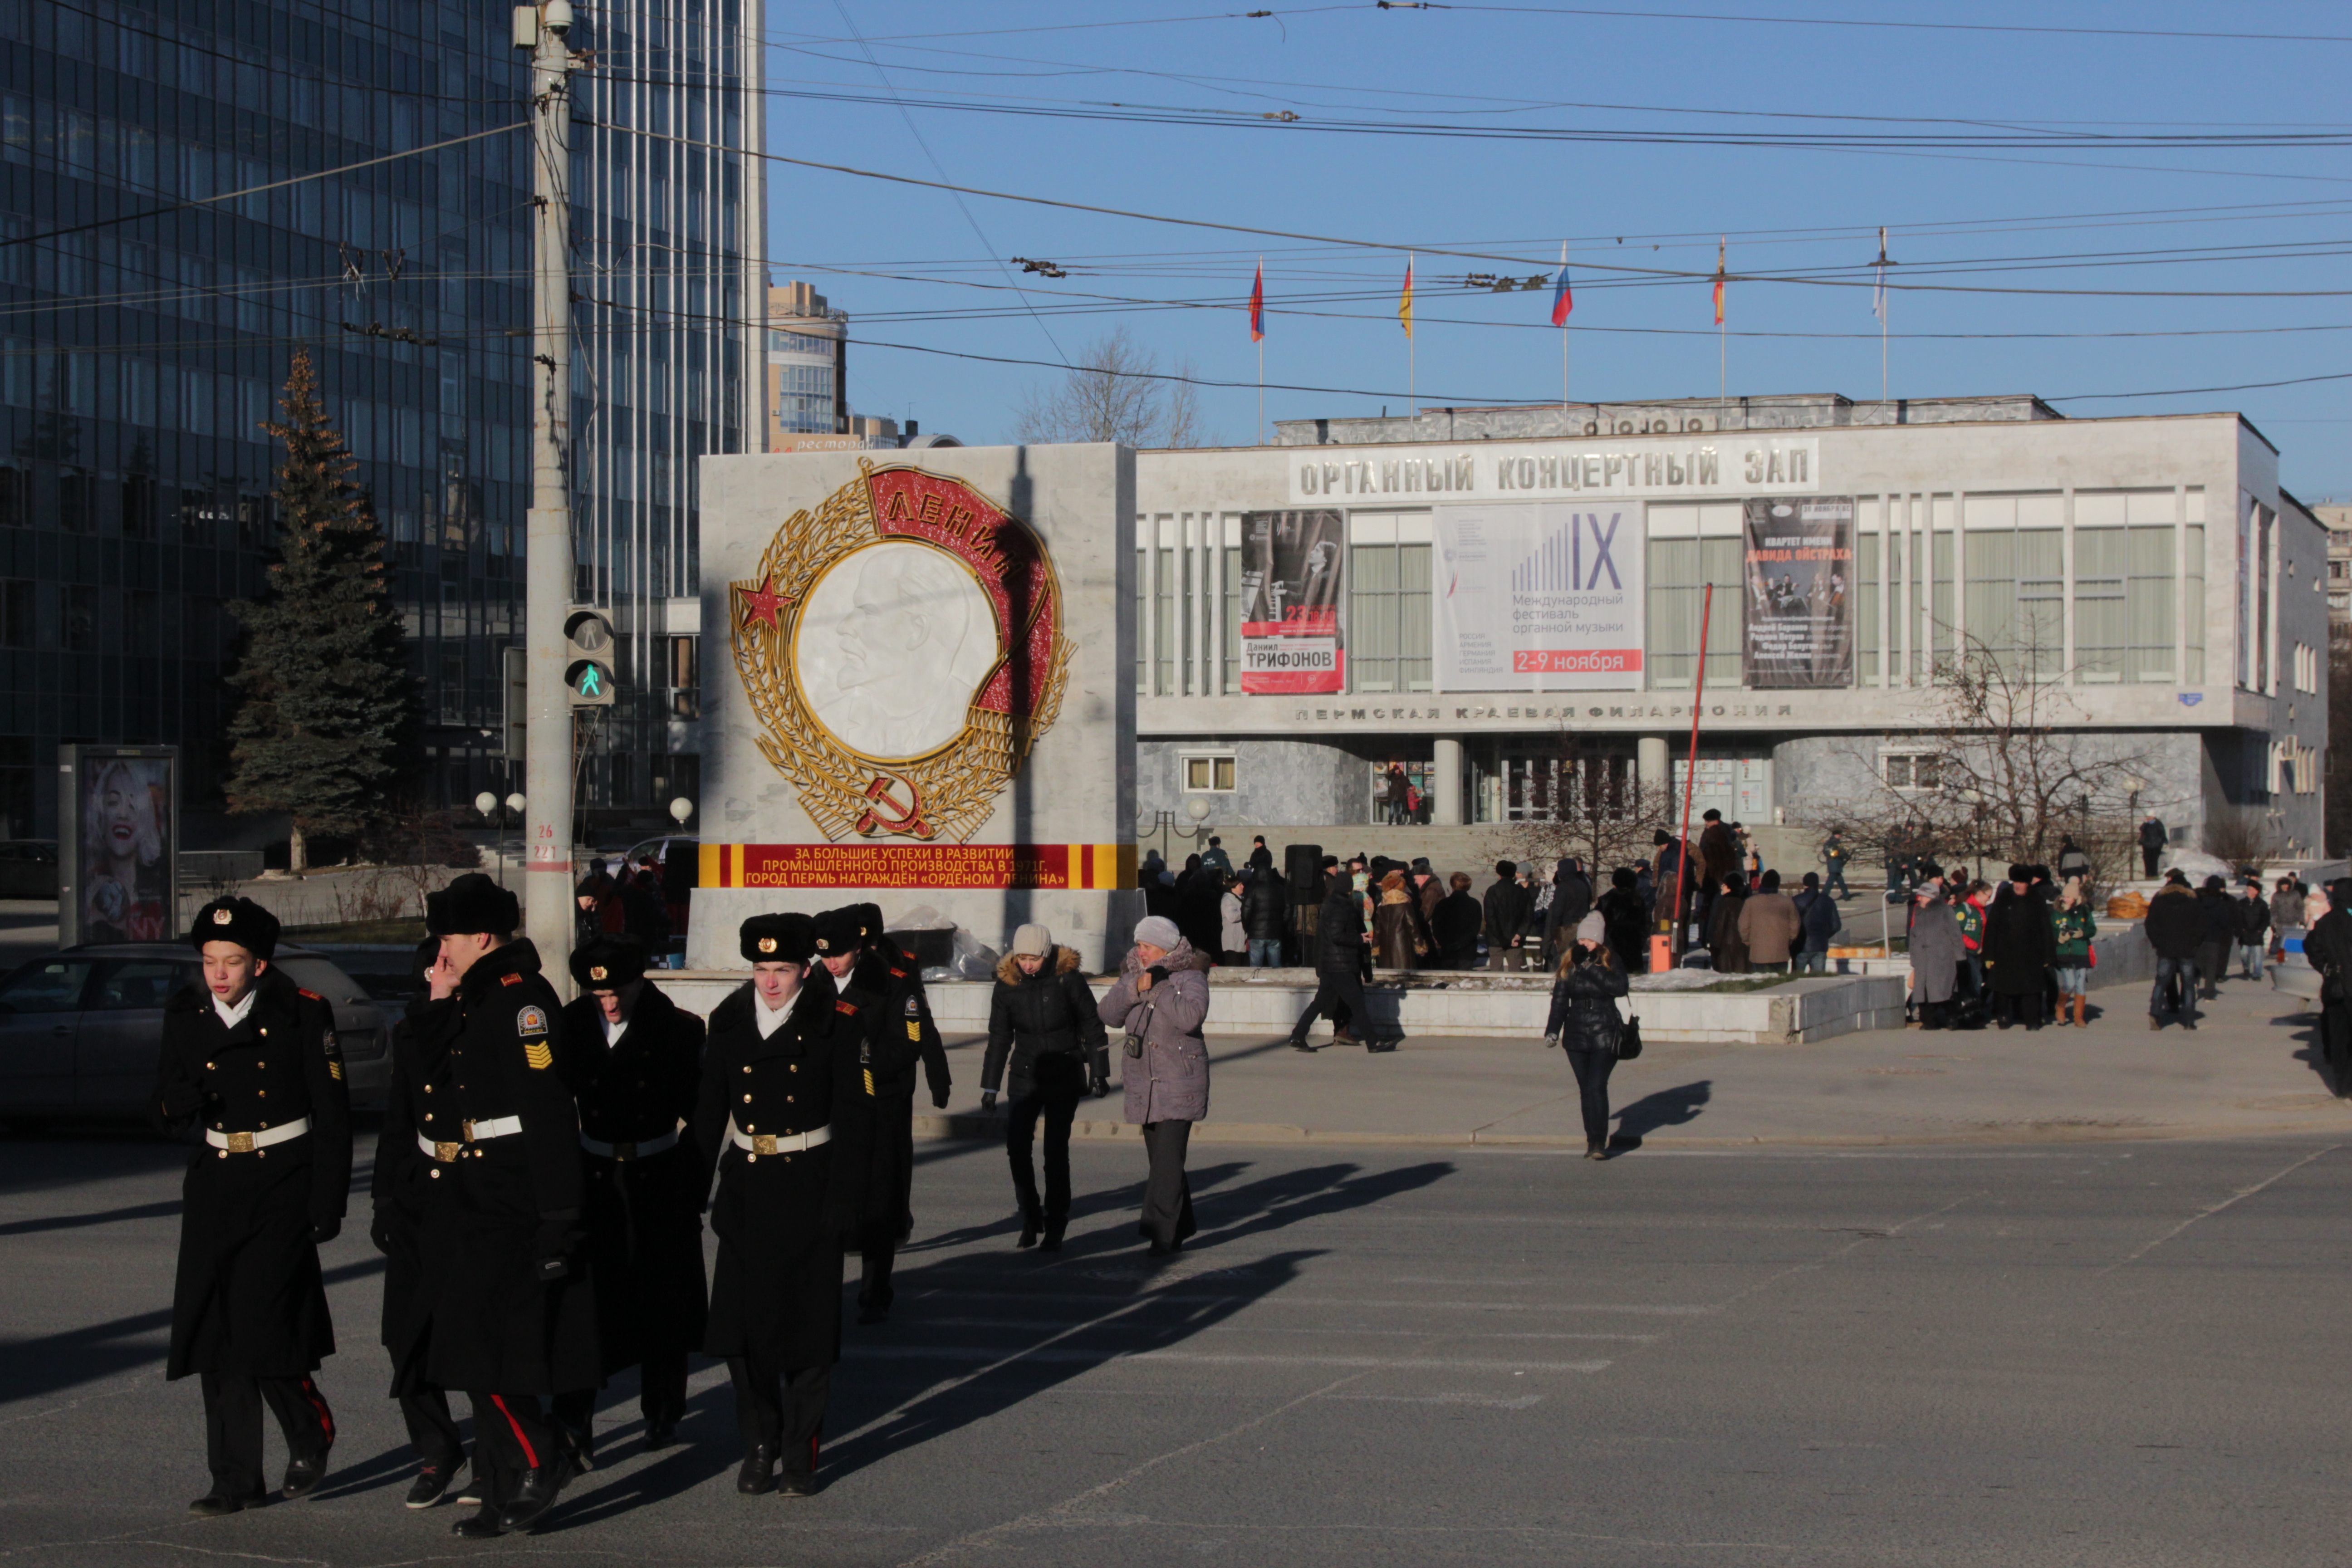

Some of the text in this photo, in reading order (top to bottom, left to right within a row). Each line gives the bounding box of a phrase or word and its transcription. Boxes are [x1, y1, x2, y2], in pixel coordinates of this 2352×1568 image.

[798, 439, 874, 451] ресторан
[1301, 453, 1474, 495] ОРГАННЫЙ
[1498, 446, 1719, 491] КОНЦЕРТНЫЙ
[887, 490, 1022, 581] ЛЕНИН
[1765, 537, 1833, 547] КВАРТЕТ ИМЕНИ
[1573, 513, 1622, 590] IX
[1746, 547, 1852, 563] ДАВИДА ОЙСТРАХА
[1513, 593, 1623, 608] Международный
[1286, 605, 1307, 622] 23
[1513, 608, 1579, 622] фестиваль
[1513, 622, 1623, 635] органной музыки
[1246, 642, 1278, 652] Даниил
[1246, 652, 1332, 668] ТРИФОНОВ
[1517, 651, 1624, 671] 2-9 ноября
[1294, 708, 1440, 720] ПЕРМСКАЯ
[1456, 706, 1575, 719] КРАЕВАЯ
[539, 824, 553, 838] 26
[534, 845, 556, 859] 221
[795, 848, 1014, 859] ЗА БОЛЬШИЕ УСПЕХИ В РАЗВИТИИ
[763, 860, 1048, 874] ПРОМЫШЛЕННОГО ПРОИЗВОДСТВА В 1971Г.
[746, 870, 1065, 887] ГОРОД ПЕРМЬ НАГРАЖДЁН «ОРДЕНОМ ЛЕНИНА»
